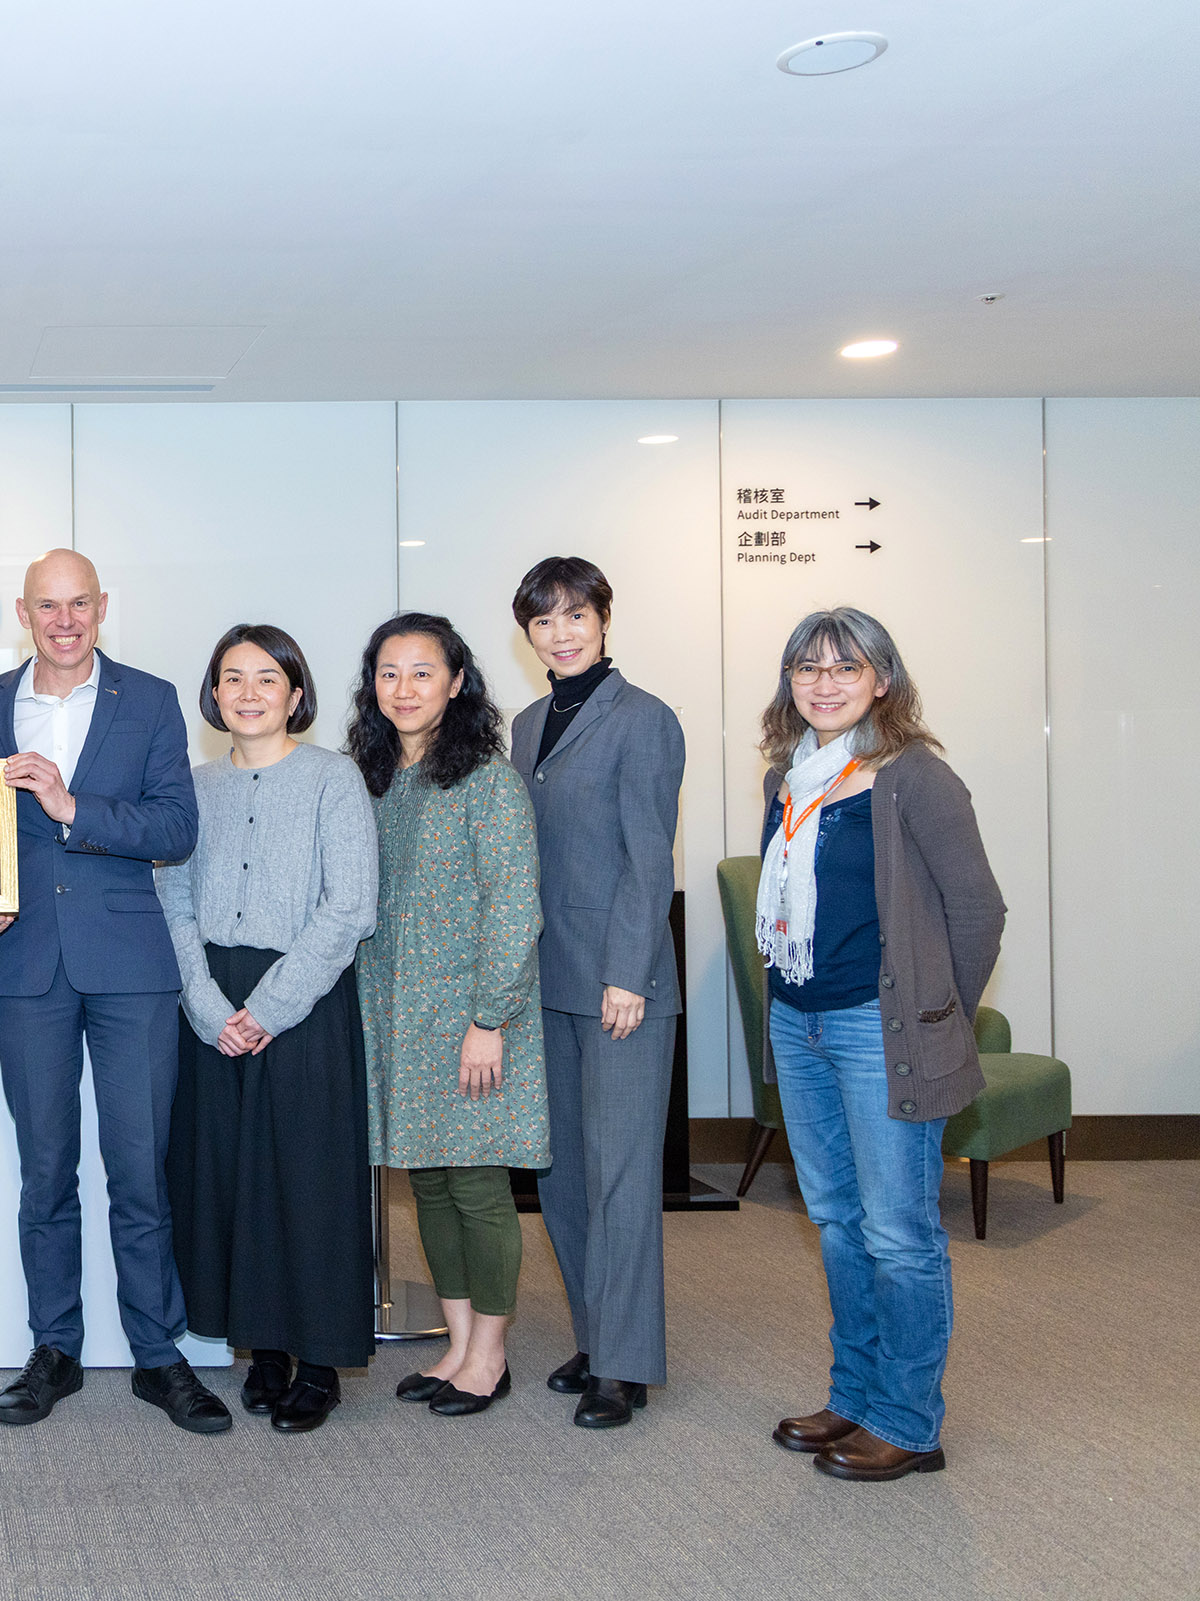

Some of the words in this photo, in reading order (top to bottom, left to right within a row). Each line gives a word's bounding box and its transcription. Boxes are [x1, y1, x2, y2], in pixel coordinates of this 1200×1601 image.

[737, 488, 785, 504] 稽核室
[737, 509, 768, 520] Audit
[771, 510, 840, 522] Department
[737, 531, 786, 547] 企劃部
[737, 552, 787, 565] Planning
[790, 553, 816, 564] Dept
